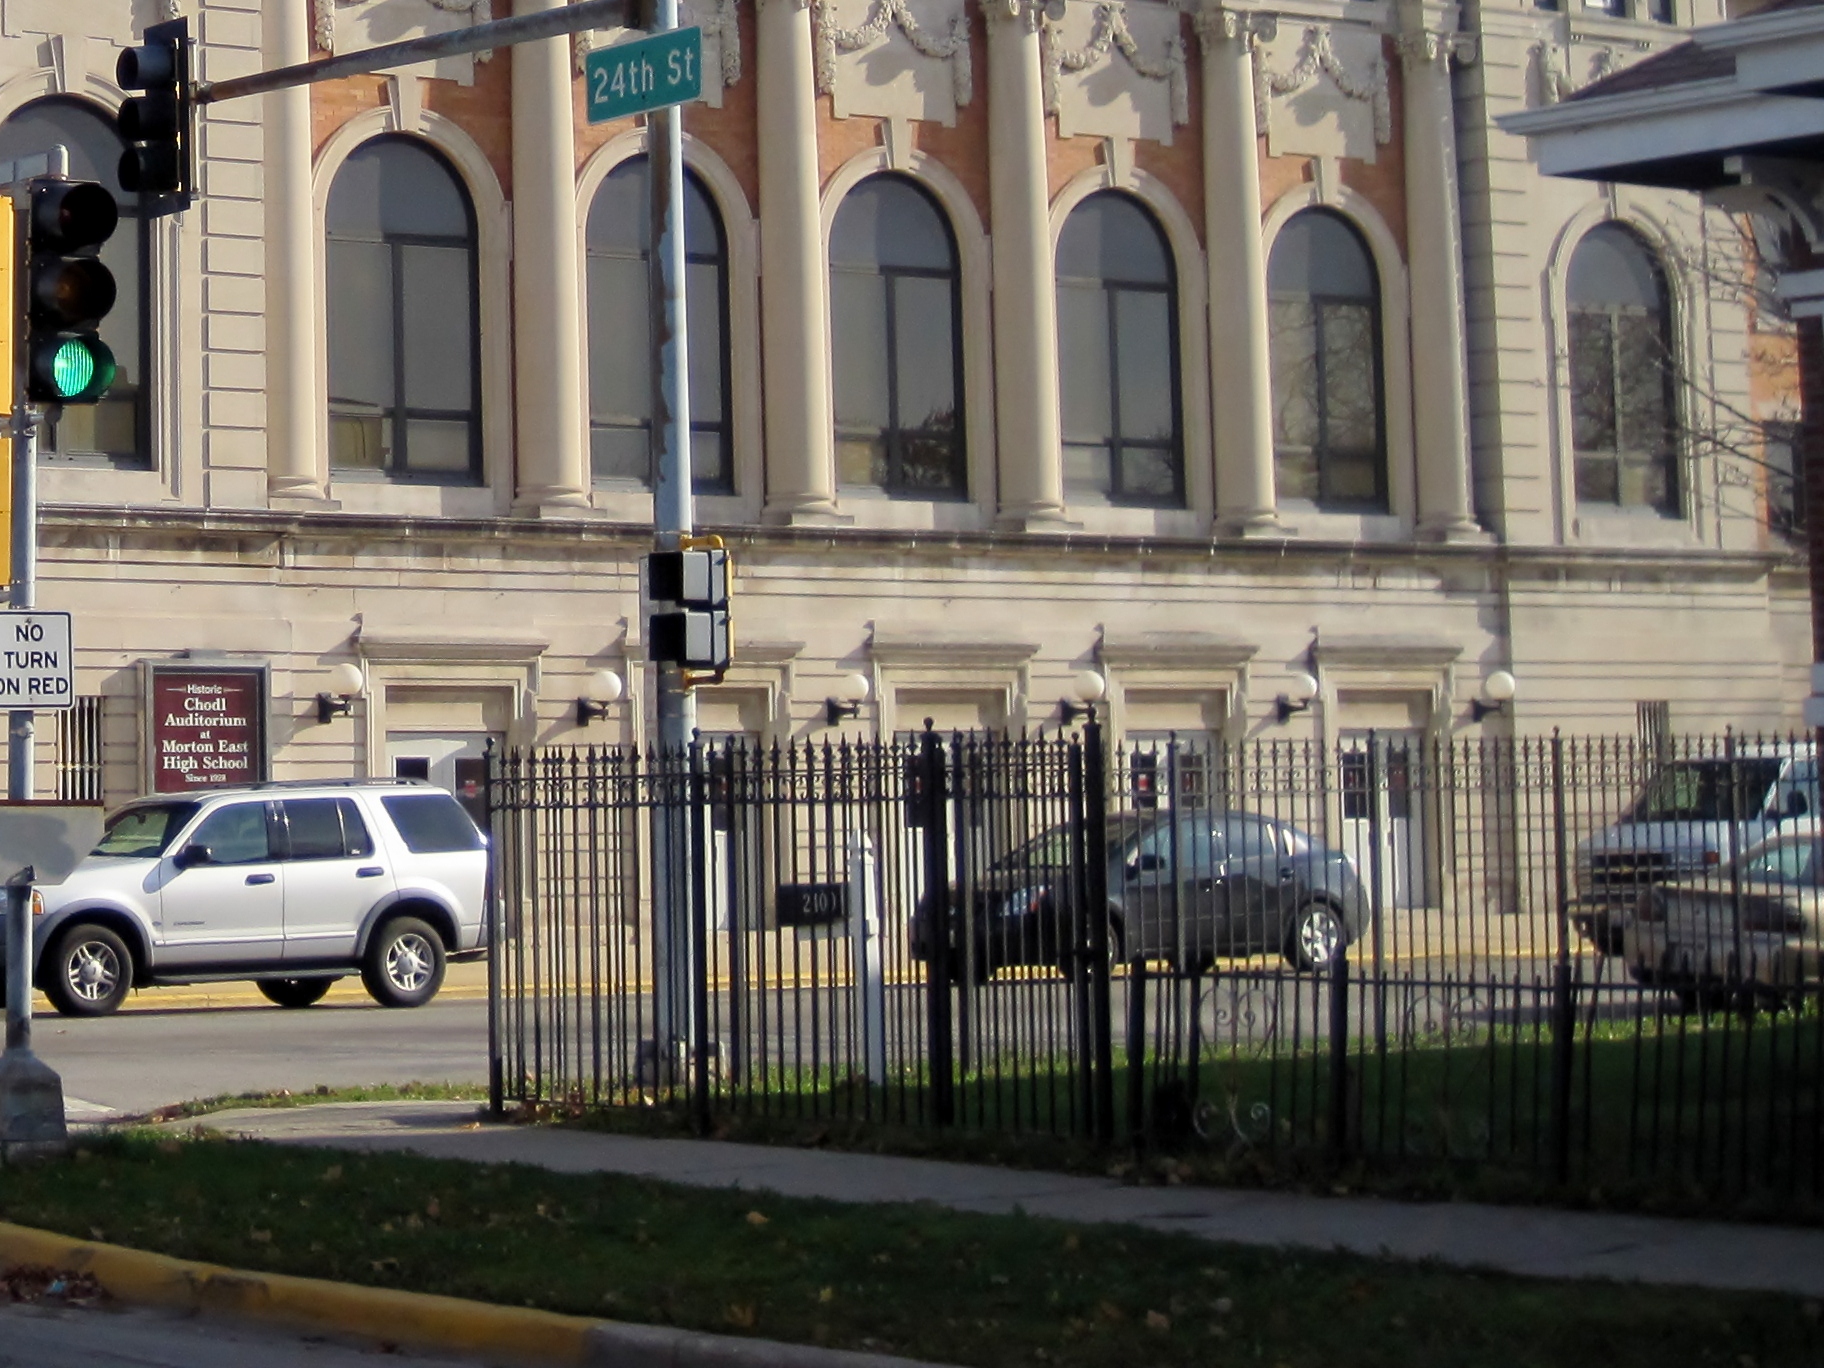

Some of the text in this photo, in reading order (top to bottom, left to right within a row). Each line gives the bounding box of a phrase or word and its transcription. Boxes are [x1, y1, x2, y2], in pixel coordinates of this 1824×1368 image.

[594, 47, 694, 104] 24th St
[15, 624, 44, 642] NO
[3, 651, 58, 669] TURN
[28, 677, 69, 695] RED
[186, 684, 223, 695] Historic
[183, 697, 227, 712] Chodl
[164, 713, 248, 727] Auditorium
[199, 729, 211, 739] at
[162, 740, 249, 753] Morton East
[162, 757, 248, 773] High School
[184, 774, 208, 783] Since
